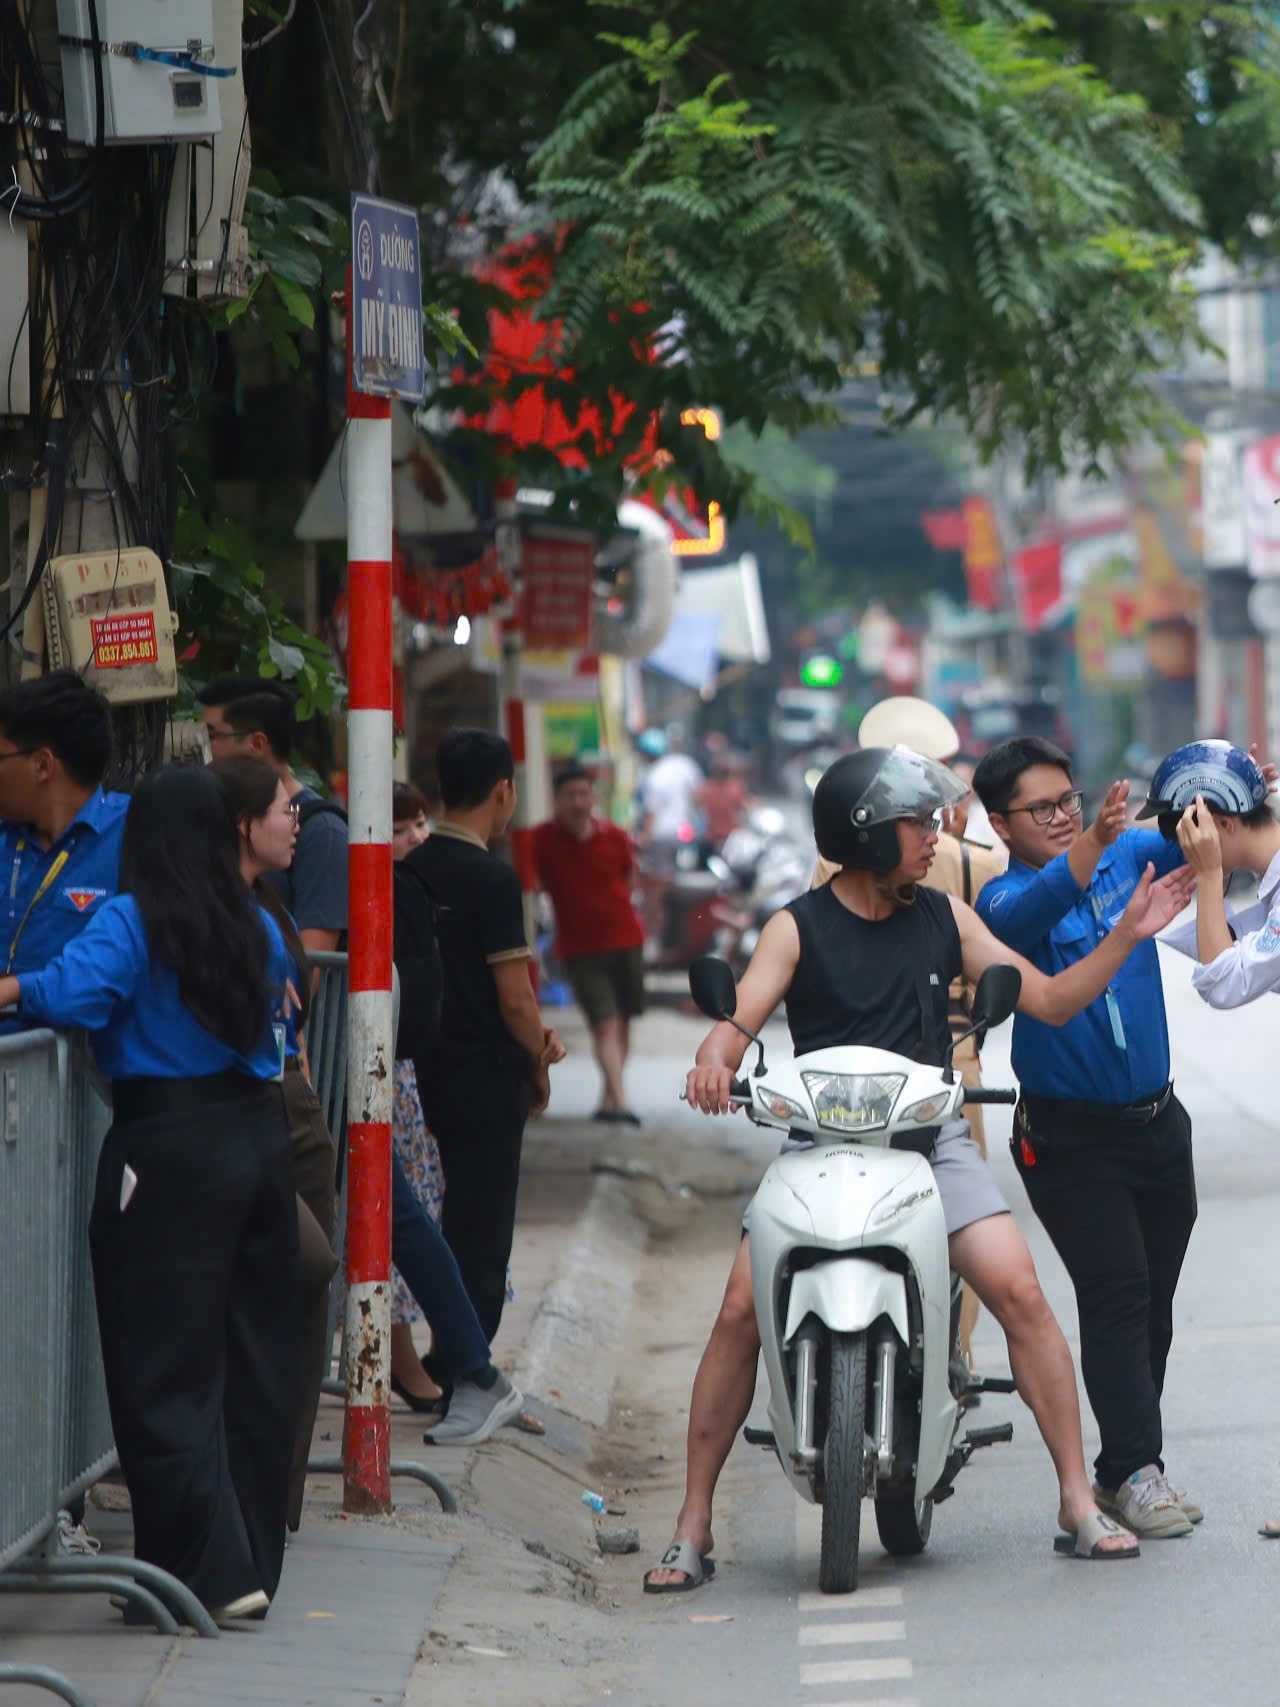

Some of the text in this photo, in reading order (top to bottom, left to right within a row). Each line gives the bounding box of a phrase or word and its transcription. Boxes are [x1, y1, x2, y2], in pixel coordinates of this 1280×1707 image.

[380, 224, 415, 273] ĐƯỜNG
[361, 287, 420, 369] MỸ ĐÌNH
[825, 1149, 864, 1159] HONDA
